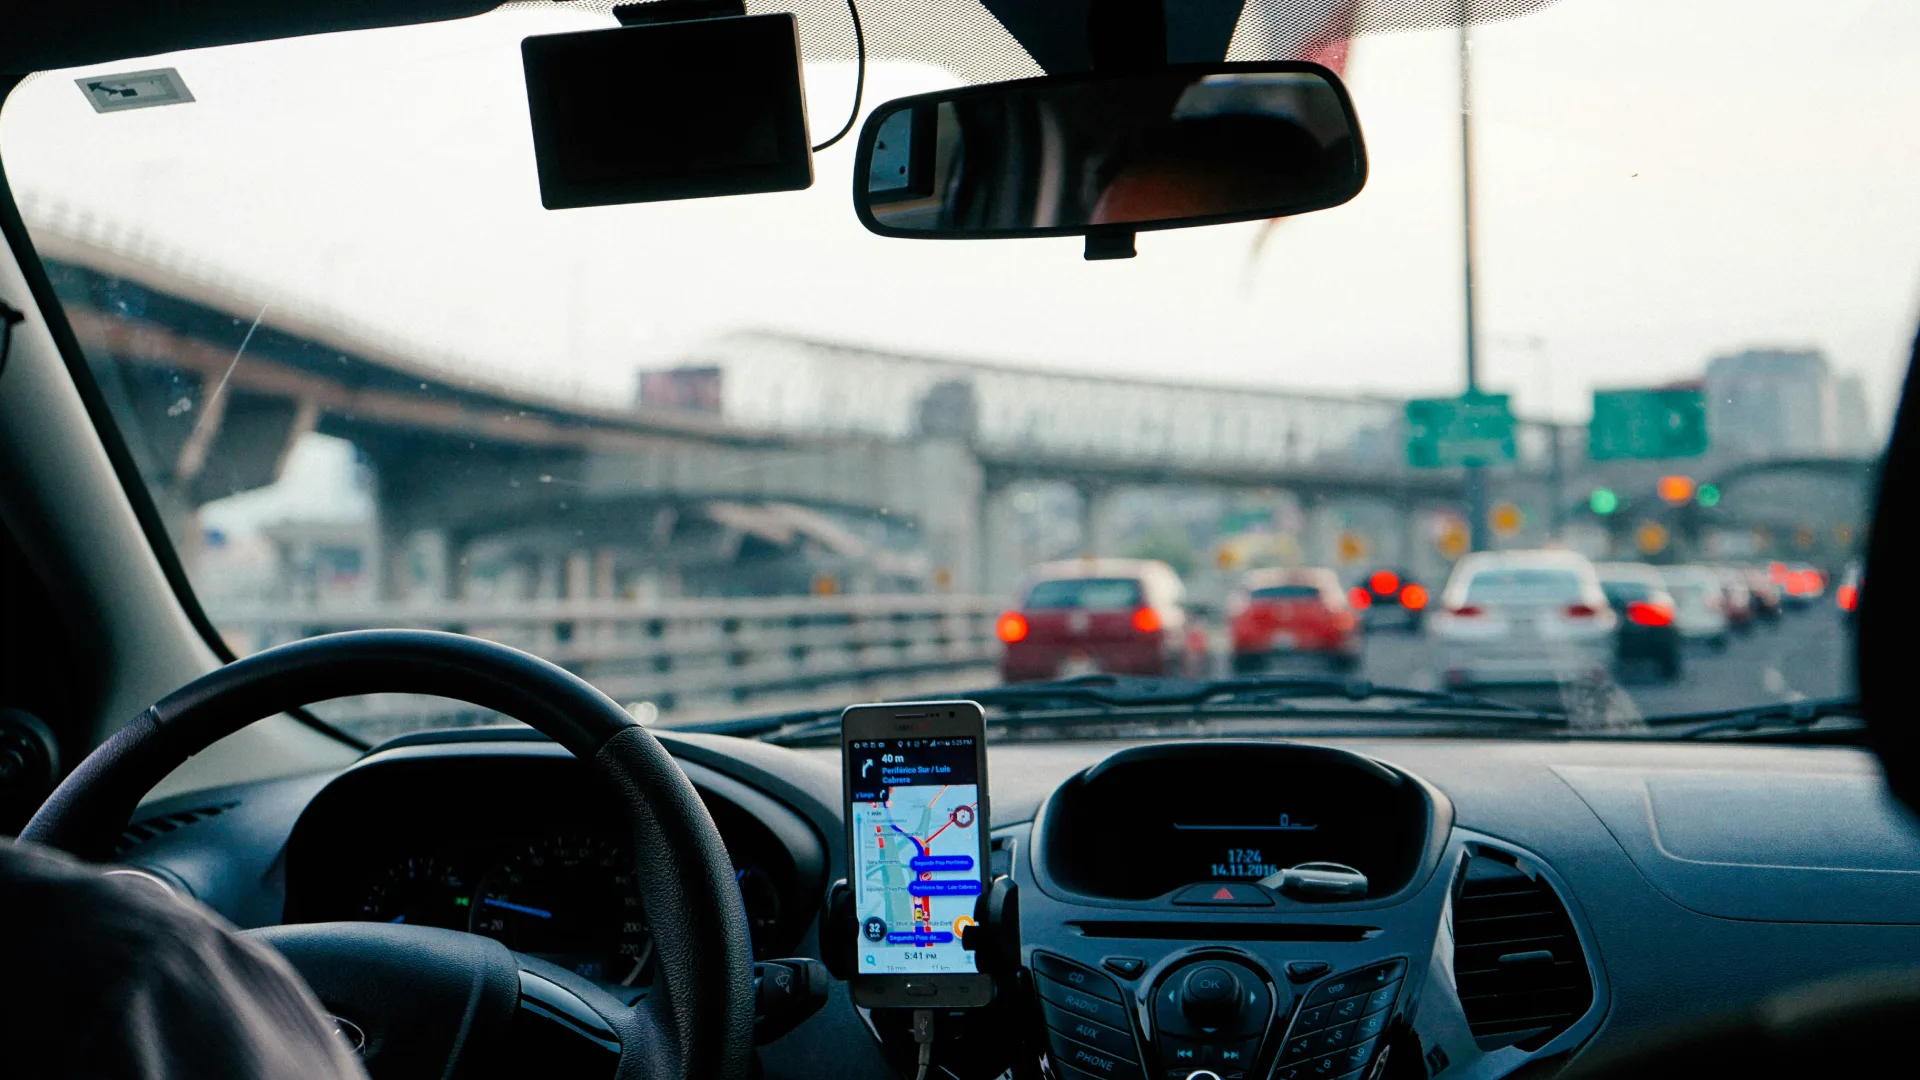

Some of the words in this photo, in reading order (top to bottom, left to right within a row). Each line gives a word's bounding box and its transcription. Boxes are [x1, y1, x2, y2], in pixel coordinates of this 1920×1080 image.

[881, 754, 894, 763] 40
[895, 755, 904, 763] m
[918, 766, 931, 774] Sur
[936, 765, 951, 773] Luis
[882, 776, 910, 784] Cabrera
[1279, 812, 1289, 827] 0
[1227, 849, 1262, 863] 17:24
[1210, 863, 1278, 876] 14.11.2016
[624, 922, 641, 932] 200
[869, 923, 880, 933] 32
[619, 944, 639, 955] 220
[904, 952, 923, 960] 5:41
[1069, 972, 1084, 983] CD
[1200, 979, 1220, 989] OK
[1328, 983, 1345, 994] DSP
[1380, 991, 1387, 1000] 3
[1065, 995, 1099, 1013] RADIO
[1346, 1002, 1354, 1011] 2
[1314, 1012, 1320, 1020] 1
[1369, 1019, 1377, 1027] 6
[1076, 1024, 1099, 1039] AUX
[1335, 1030, 1342, 1039] 5
[1300, 1040, 1308, 1048] 4
[1357, 1048, 1364, 1057] 9
[1076, 1051, 1116, 1072] PHONE
[1323, 1059, 1331, 1068] 8
[1290, 1070, 1297, 1079] 7
